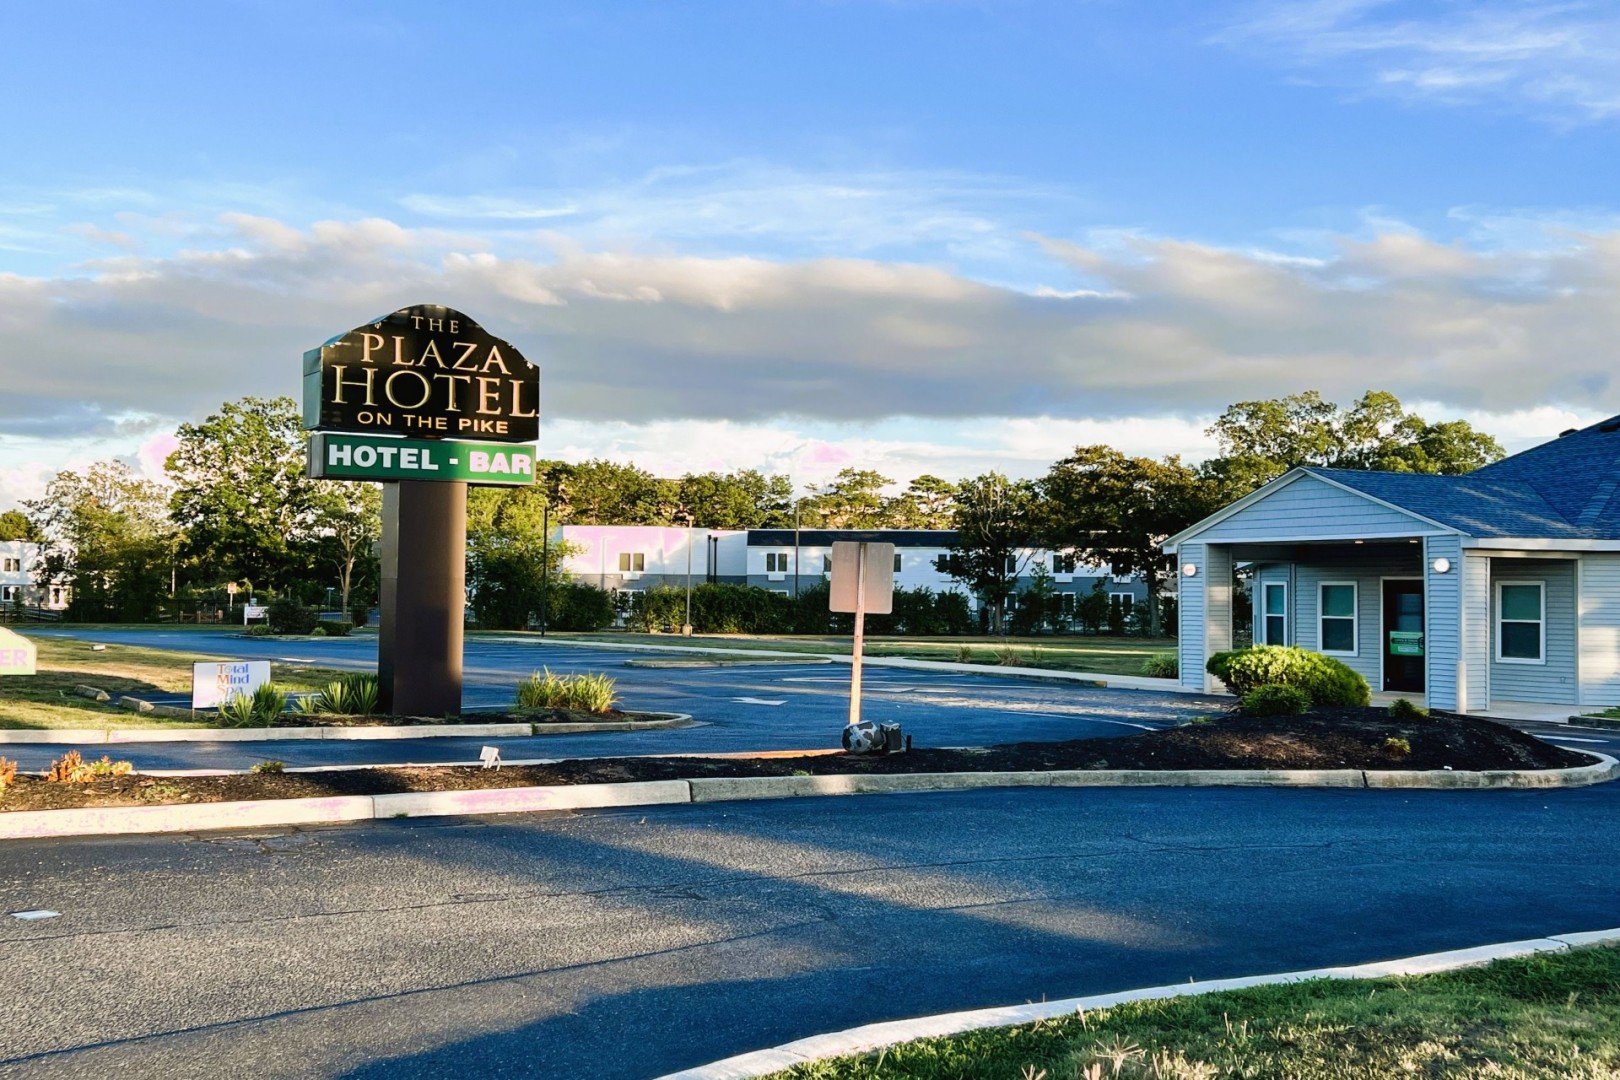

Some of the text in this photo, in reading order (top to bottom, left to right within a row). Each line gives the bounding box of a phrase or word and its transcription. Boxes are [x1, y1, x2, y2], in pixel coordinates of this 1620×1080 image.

[410, 315, 459, 334] THE
[360, 332, 512, 375] PLAZA
[330, 364, 537, 418] HOTEL
[357, 411, 509, 434] ON THE PIKE
[328, 444, 439, 471] HOTEL
[469, 451, 532, 475] BAR
[217, 663, 249, 674] Total
[217, 674, 249, 685] Mind
